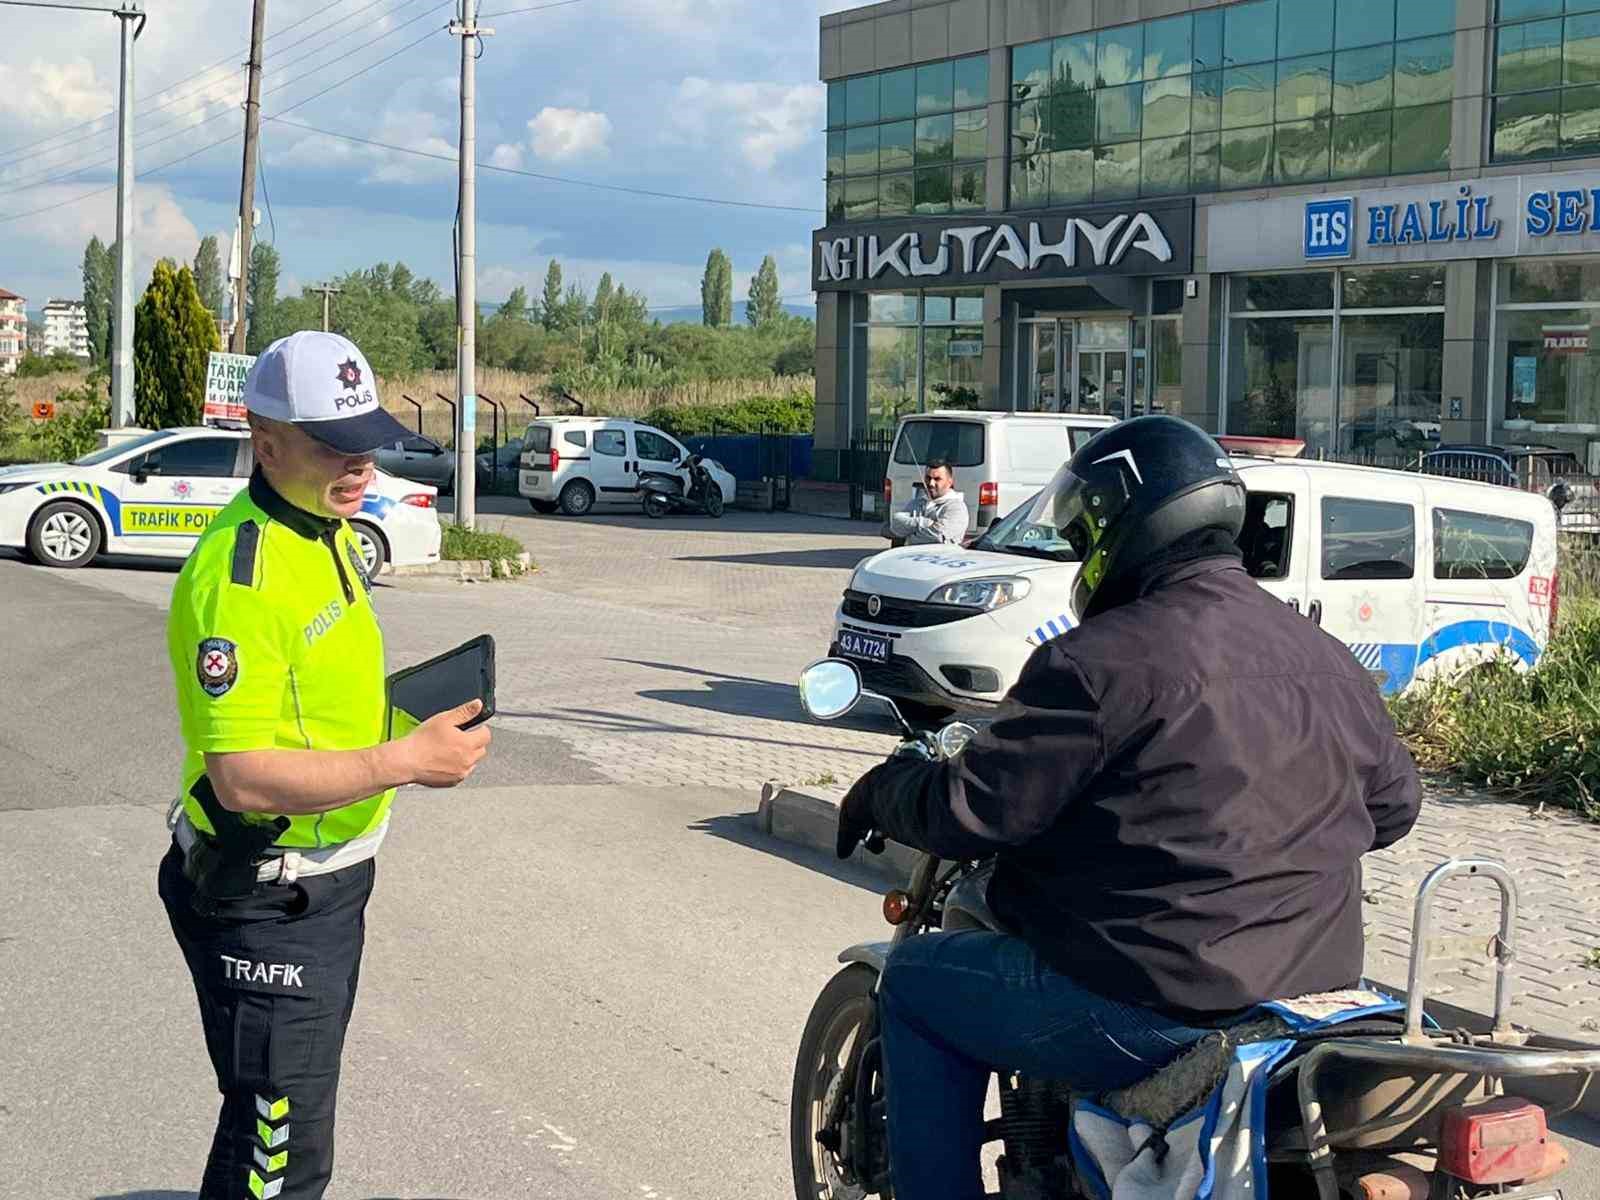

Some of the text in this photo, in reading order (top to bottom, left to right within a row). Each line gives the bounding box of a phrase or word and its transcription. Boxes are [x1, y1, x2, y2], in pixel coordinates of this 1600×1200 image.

[1309, 210, 1347, 247] HS
[1366, 184, 1499, 246] HALİL
[130, 508, 181, 528] TRAFİK
[839, 634, 887, 659] 43 A 7724
